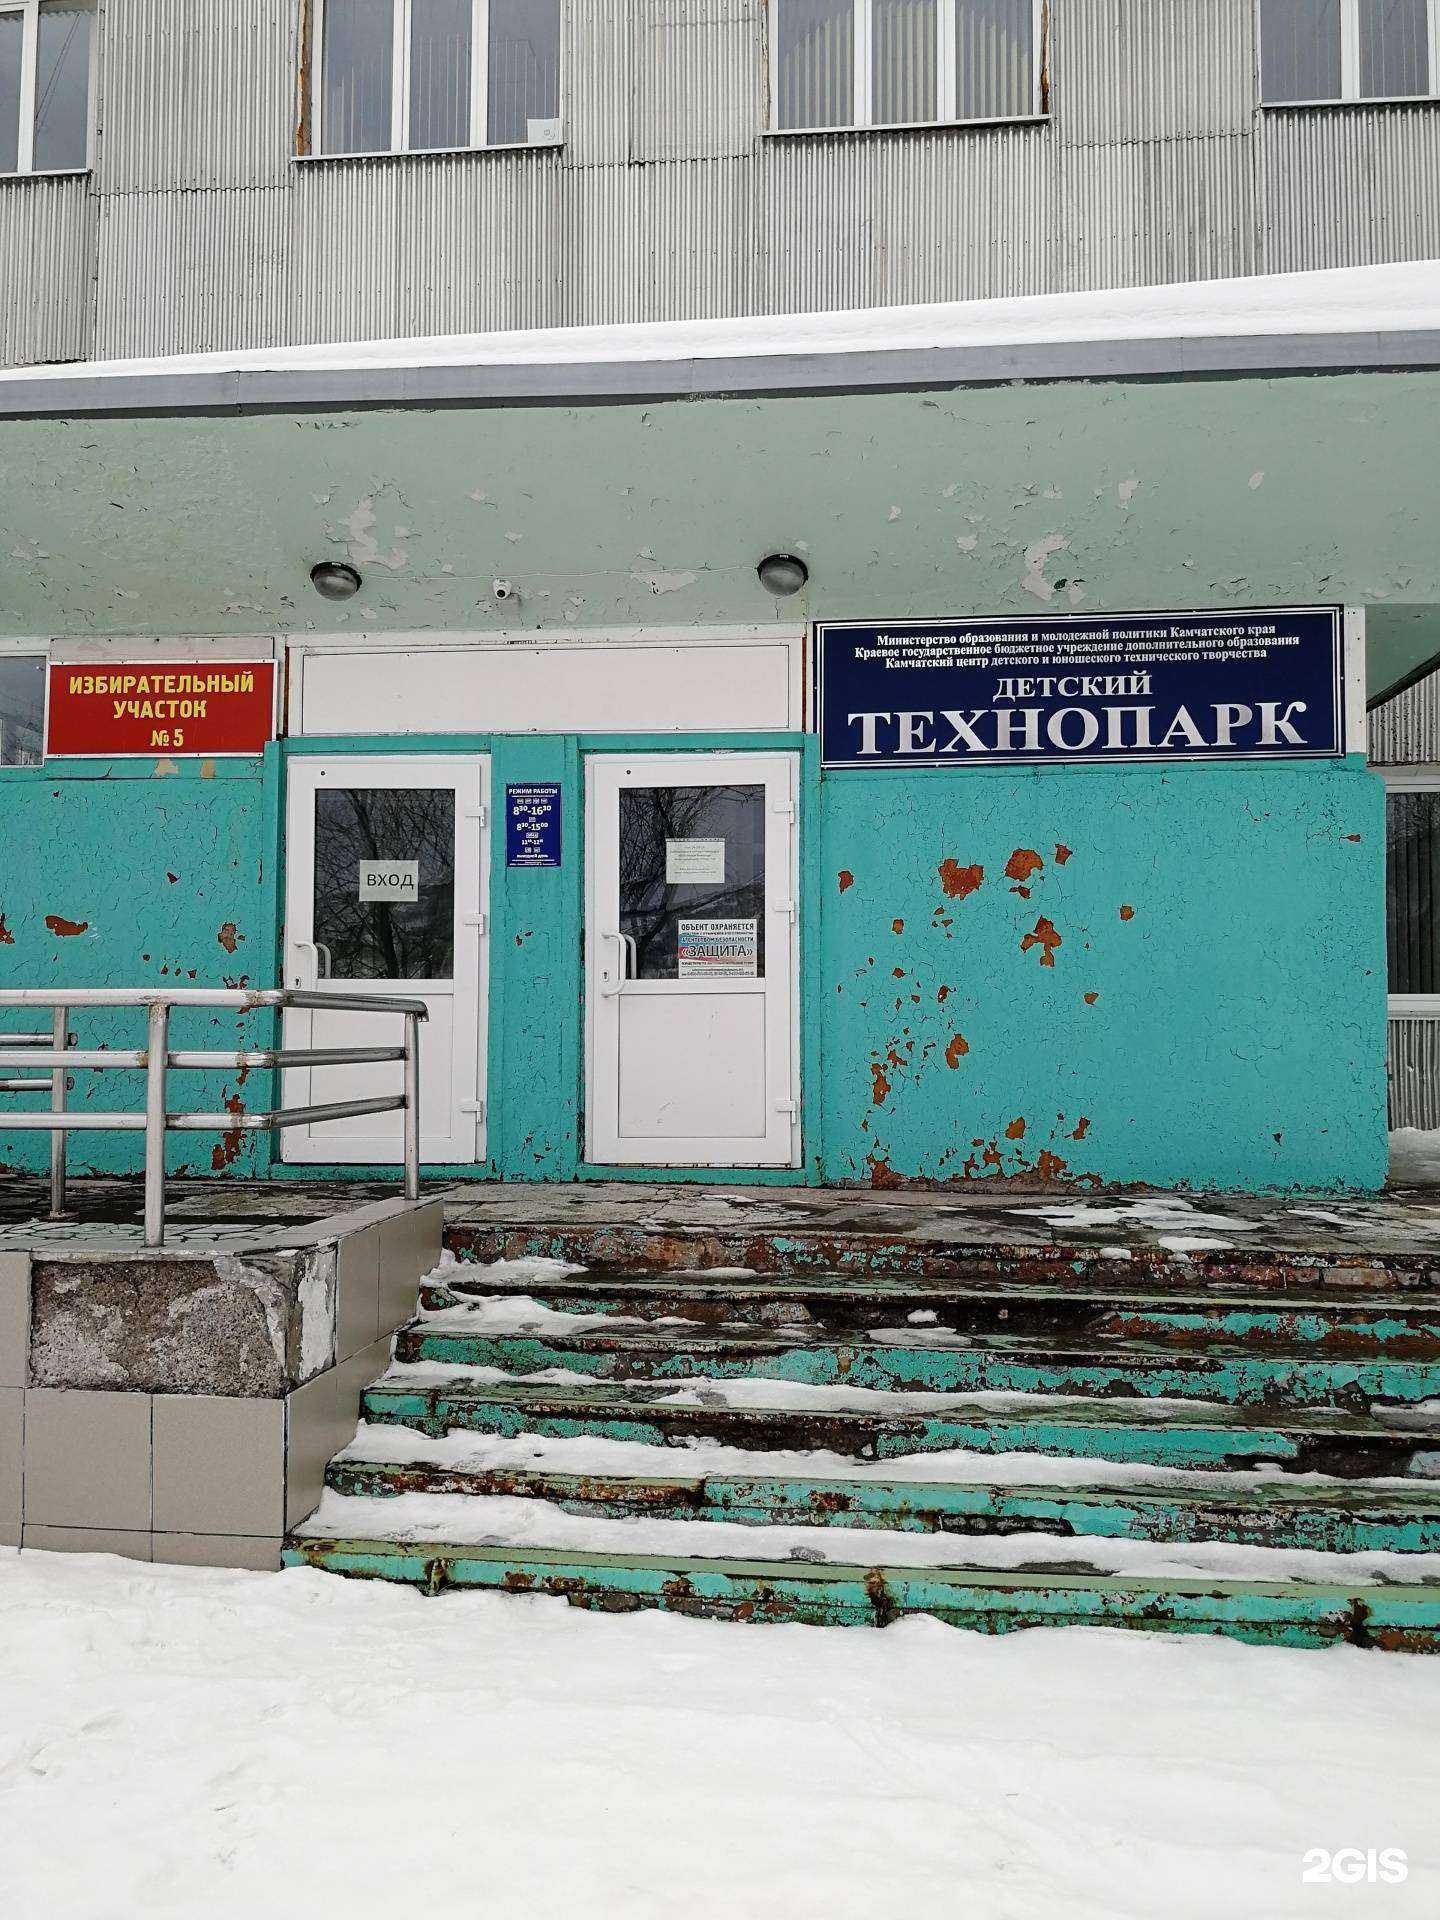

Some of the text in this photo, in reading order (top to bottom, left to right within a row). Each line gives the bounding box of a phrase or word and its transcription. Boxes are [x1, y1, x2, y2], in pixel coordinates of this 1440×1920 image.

[877, 625, 1276, 647] Министерство образования и молодежной политики Камчатского края
[855, 635, 1300, 660] Краевое государственное бюджетное учреждение дополнительного образования
[885, 648, 1268, 669] Камчатский центр детского и юношеского технического творчества
[69, 670, 254, 695] ИЗБИРАТЕЛЬНЫЙ
[992, 669, 1153, 702] ДЕТСКИЙ
[113, 699, 207, 719] УЧАСТОК
[150, 728, 184, 747] № 5
[847, 701, 1308, 755] ТЕХНОПАРК
[367, 874, 414, 890] ВХОД
[681, 923, 754, 931] ОБЪЕКТ ОХРАНЯЕТСЯ
[682, 945, 753, 959] «ЗАЩИТА»
